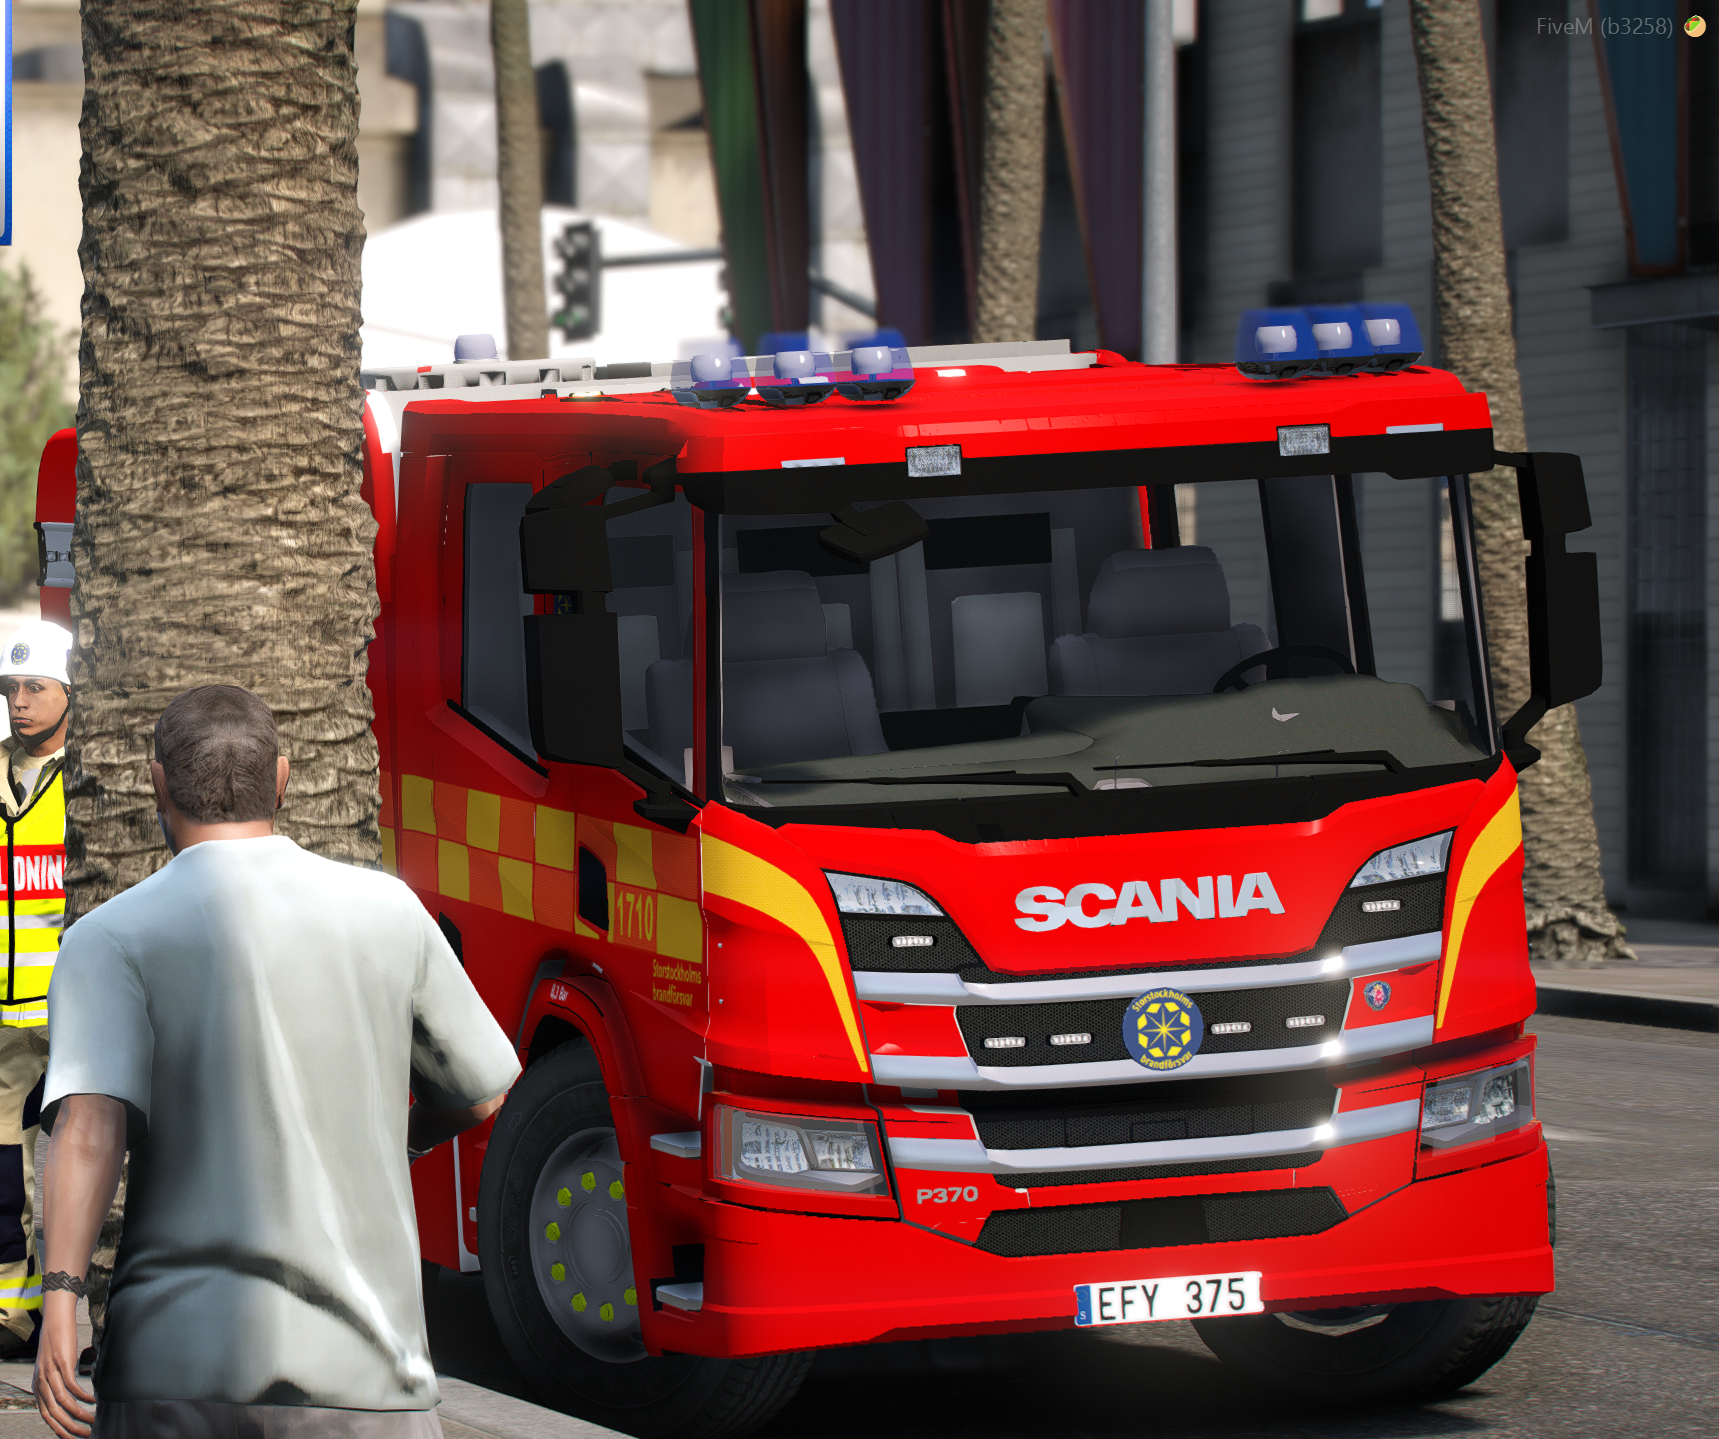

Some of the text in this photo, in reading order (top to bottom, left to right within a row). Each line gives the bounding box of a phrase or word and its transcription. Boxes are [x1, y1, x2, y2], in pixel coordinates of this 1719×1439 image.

[1014, 871, 1285, 932] SCANIA
[617, 890, 654, 941] 1710
[653, 959, 701, 984] Storstockholms
[1132, 989, 1193, 1012] Storstockholms
[1140, 1050, 1193, 1069] brandförsvar
[917, 1186, 979, 1204] P370
[1099, 1277, 1245, 1321] EFY 375
[1080, 1311, 1086, 1320] S
